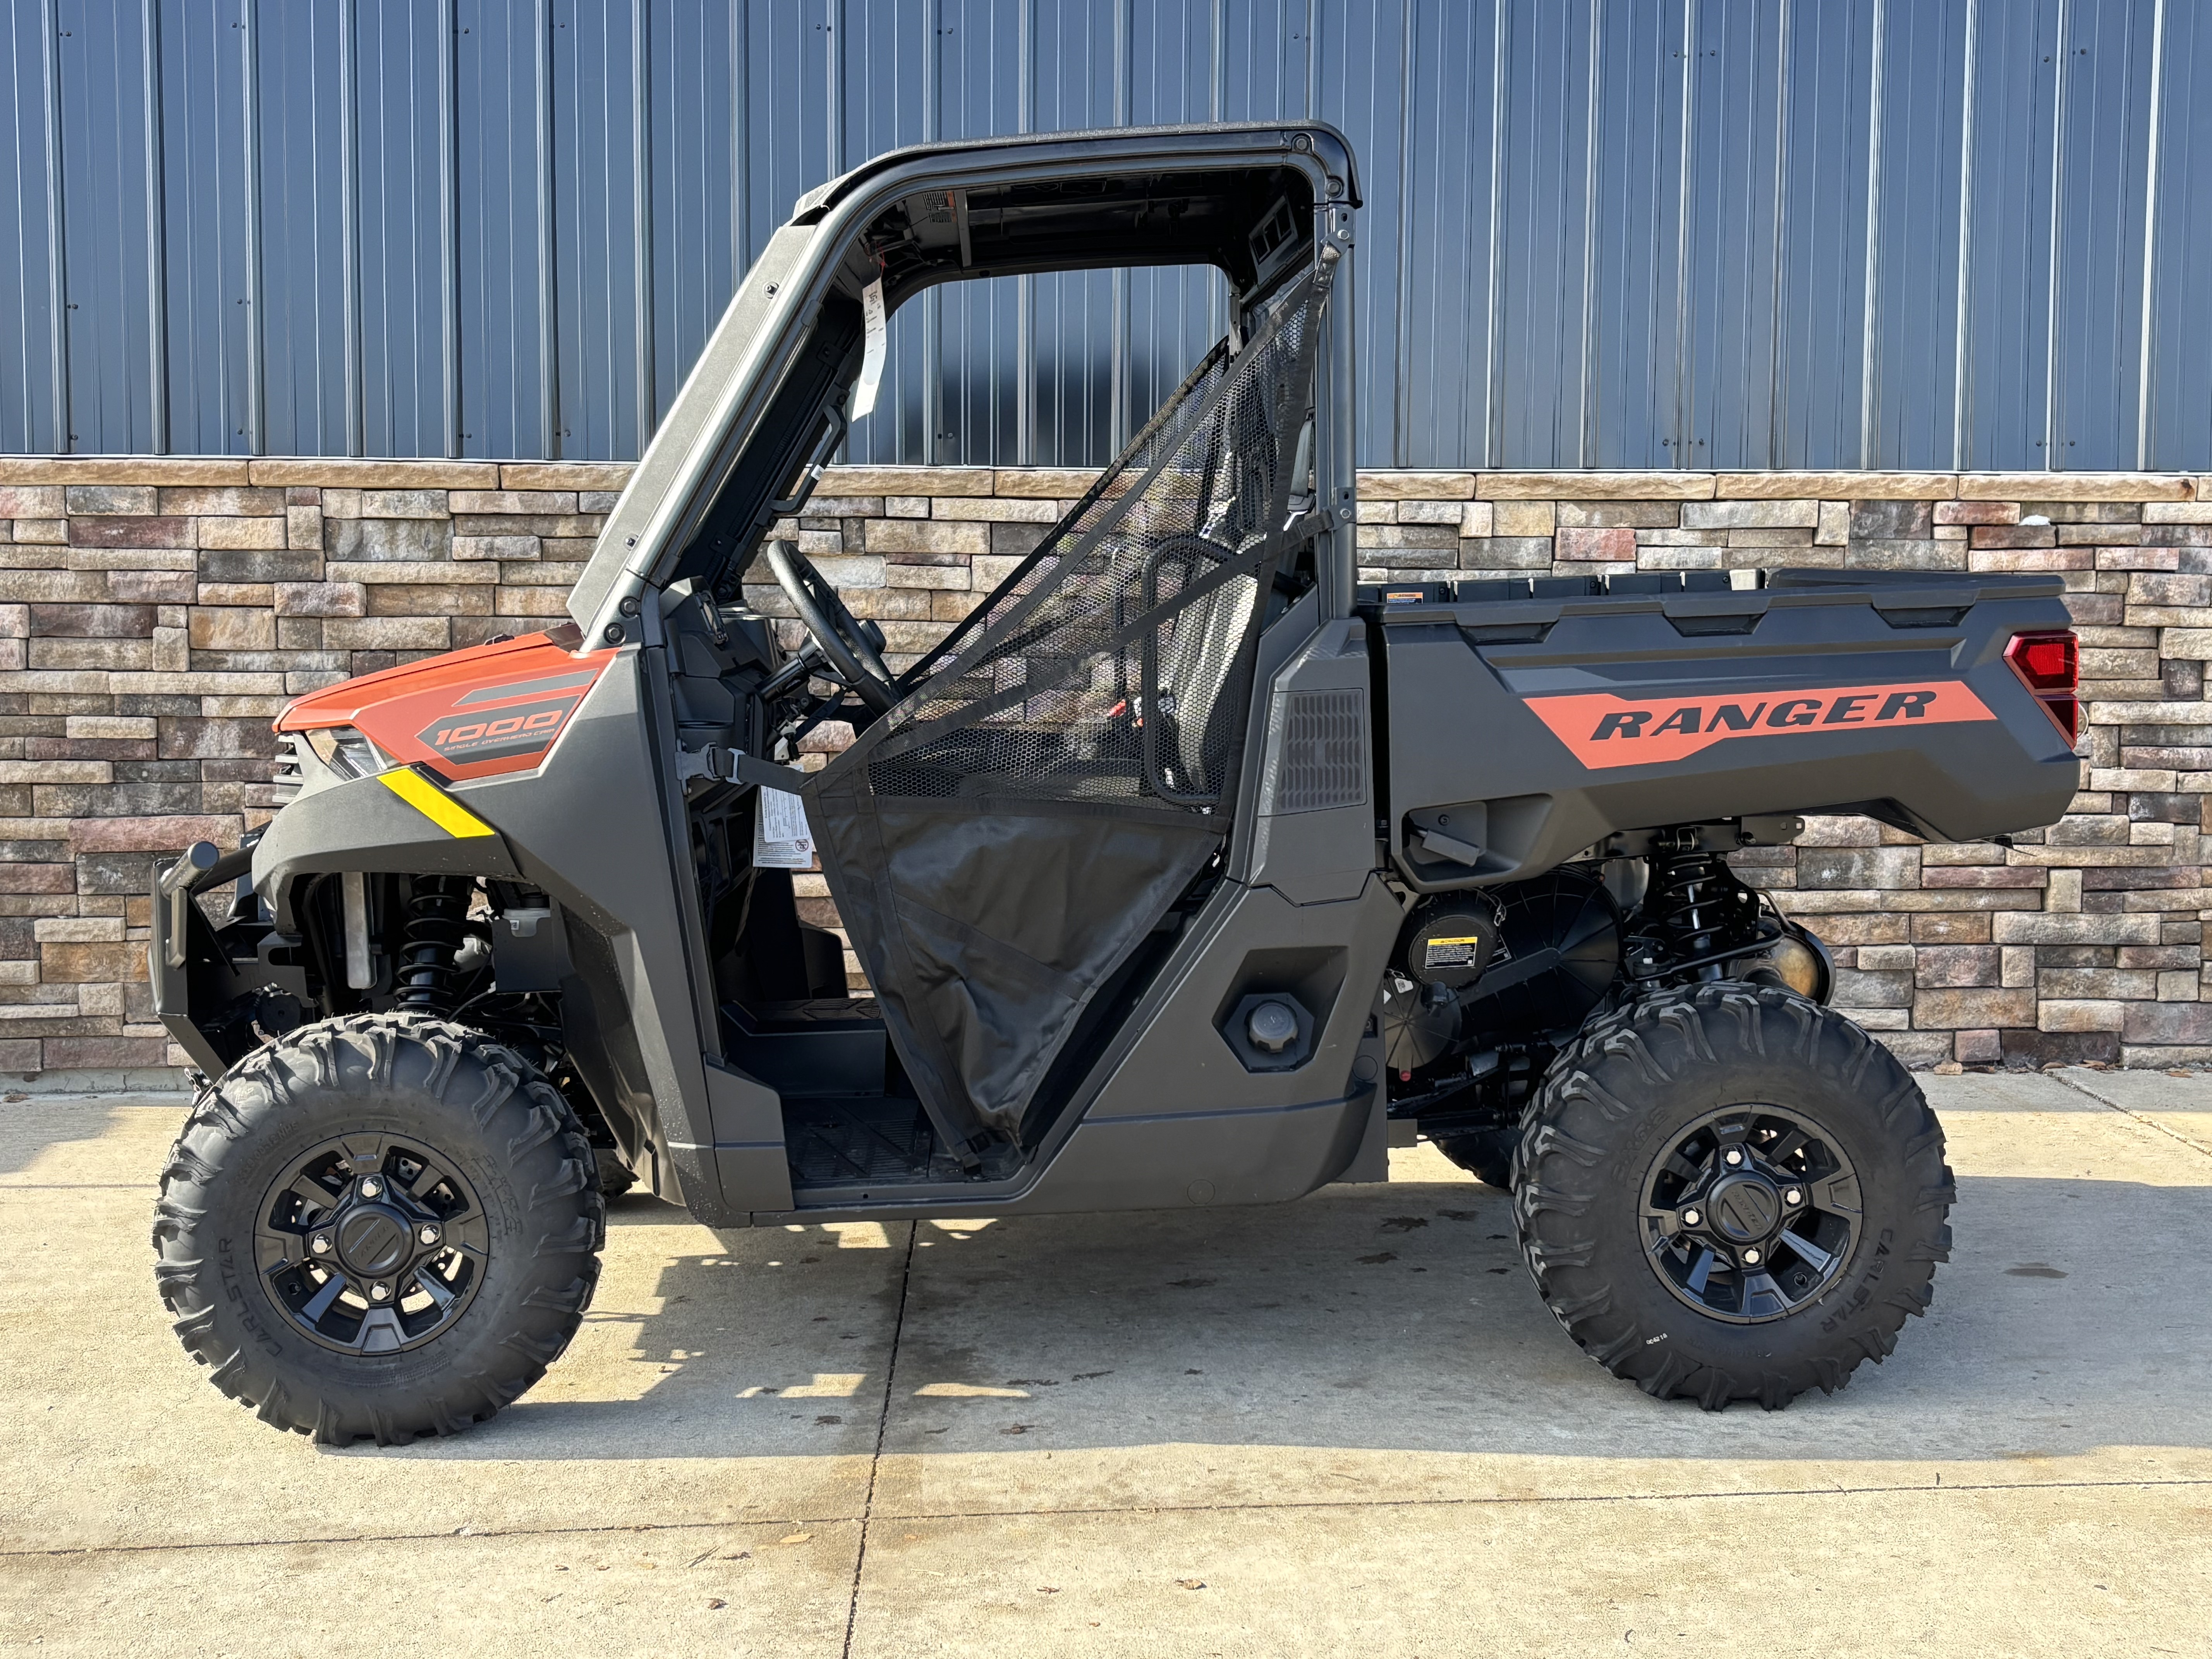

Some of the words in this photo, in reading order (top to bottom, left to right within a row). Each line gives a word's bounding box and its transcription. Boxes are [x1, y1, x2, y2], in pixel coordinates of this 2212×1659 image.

[435, 710, 563, 745] 1000
[1589, 691, 1937, 740] RANGER
[444, 741, 479, 752] SINGLE
[218, 1238, 283, 1357] CARLSTAR
